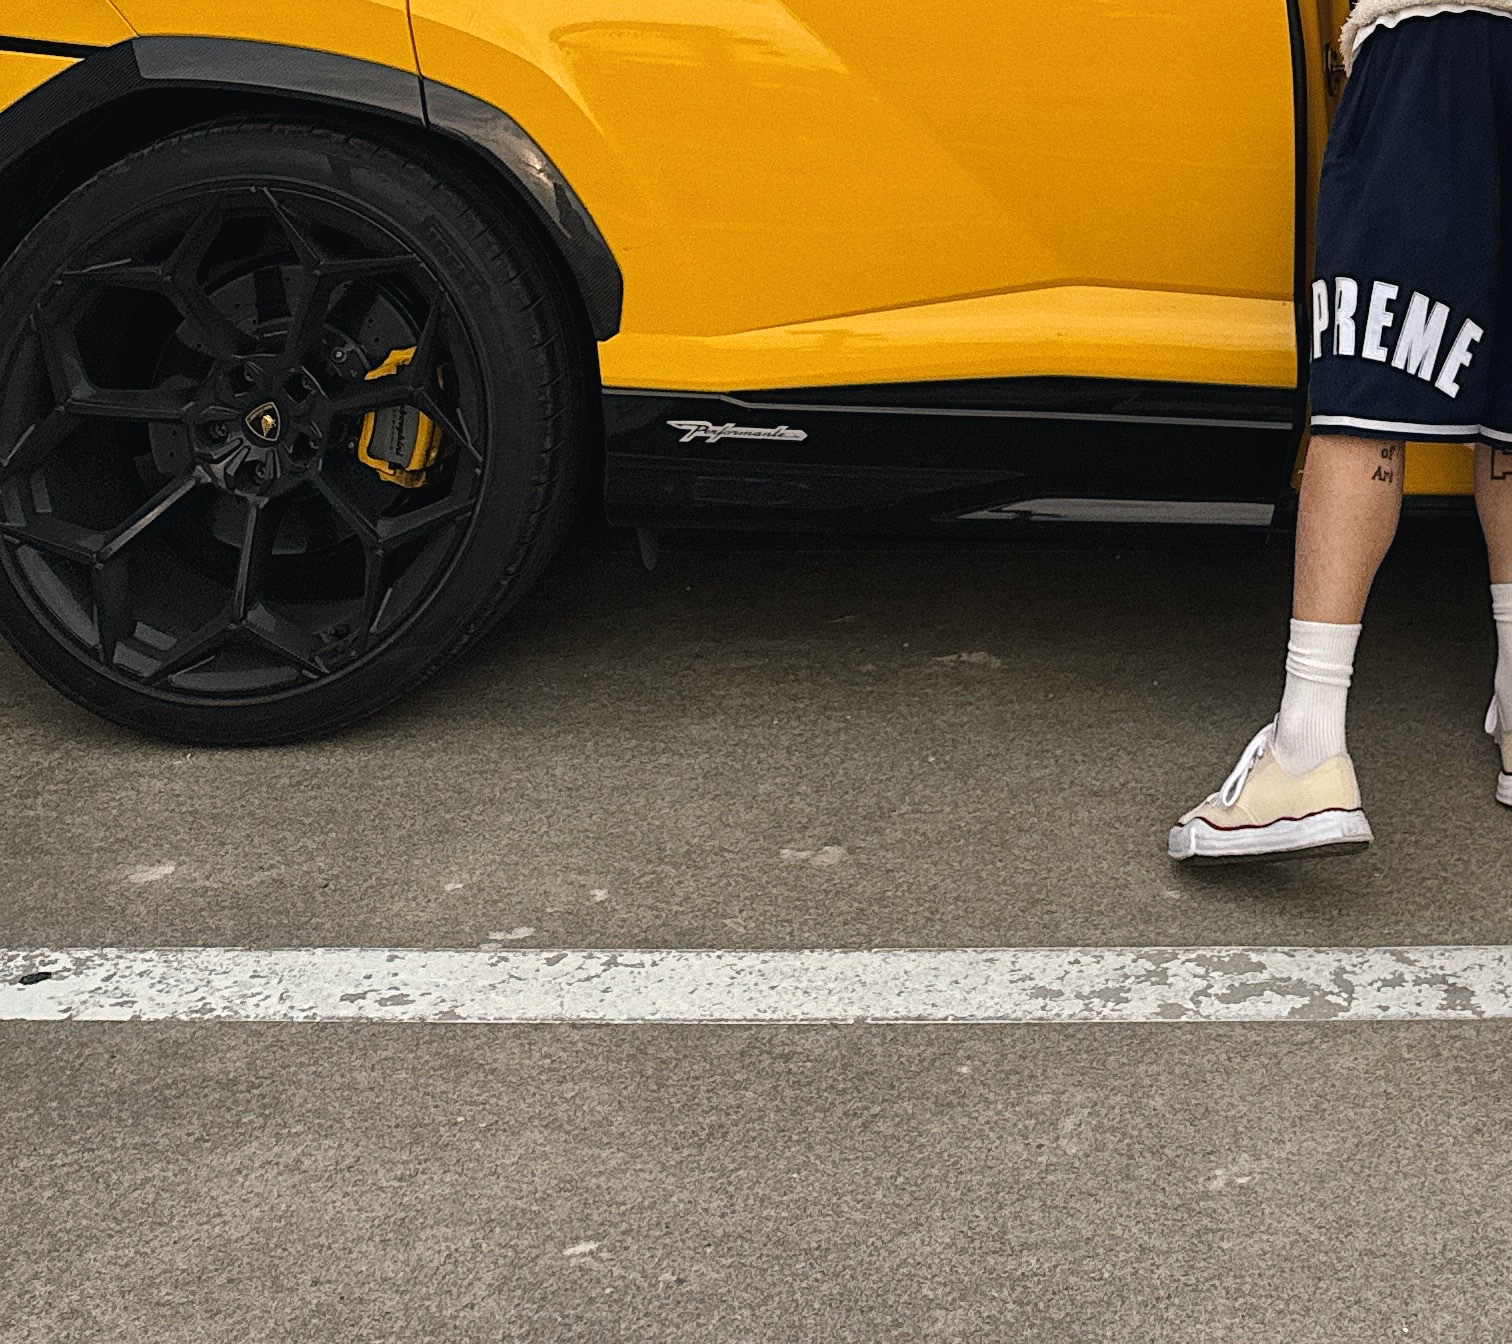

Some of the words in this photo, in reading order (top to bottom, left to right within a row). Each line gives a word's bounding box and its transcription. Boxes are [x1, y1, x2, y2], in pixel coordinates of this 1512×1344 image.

[1311, 276, 1485, 399] PREME
[667, 420, 803, 443] Performante
[1380, 445, 1396, 461] of
